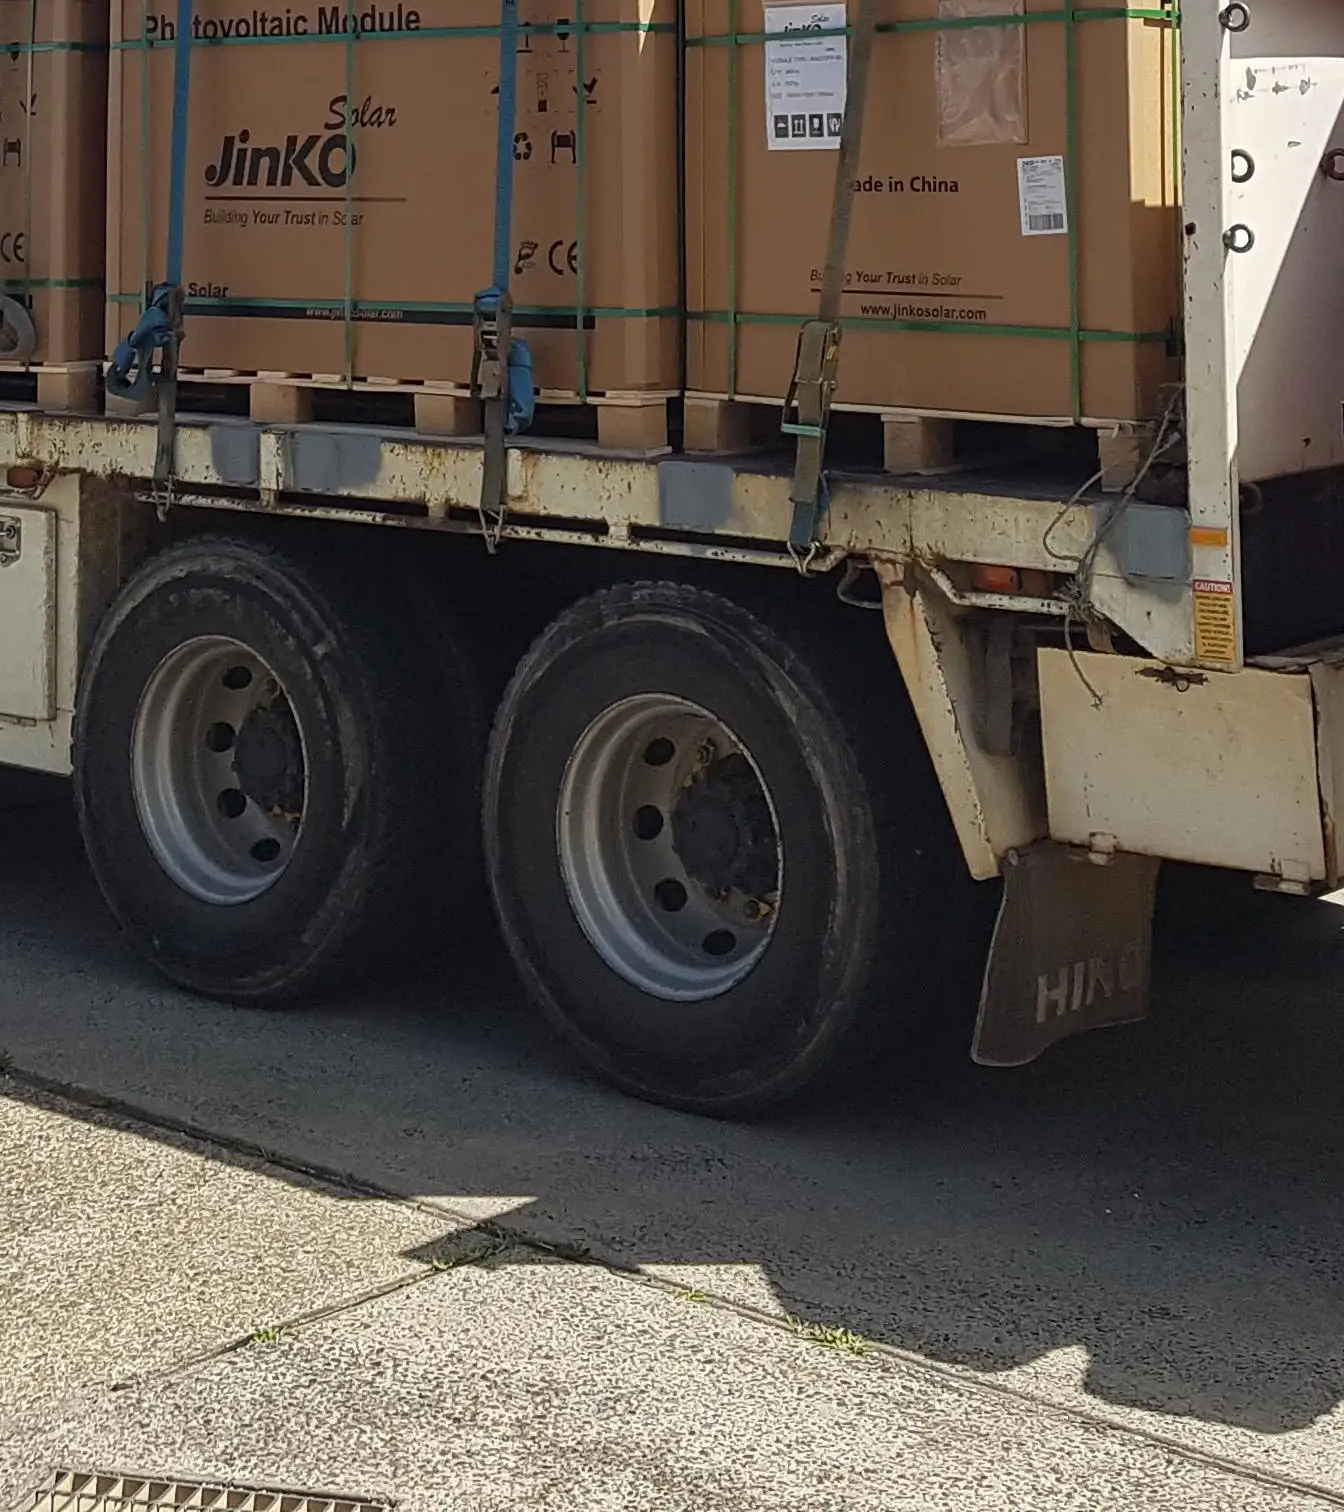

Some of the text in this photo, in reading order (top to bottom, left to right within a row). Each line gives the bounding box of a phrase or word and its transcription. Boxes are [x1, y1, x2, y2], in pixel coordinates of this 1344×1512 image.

[146, 3, 422, 41] Phtovoltaic Module
[204, 128, 357, 189] JinKO
[851, 176, 959, 193] ade in China
[204, 208, 365, 228] Building Your Trust in Soar
[856, 270, 883, 284] Your
[886, 271, 916, 285] Trust
[918, 272, 929, 286] in
[932, 273, 963, 287] Solar
[188, 282, 230, 299] Solar
[860, 303, 987, 321] www.jinkosolar.com
[1195, 581, 1231, 594] CAUTION!
